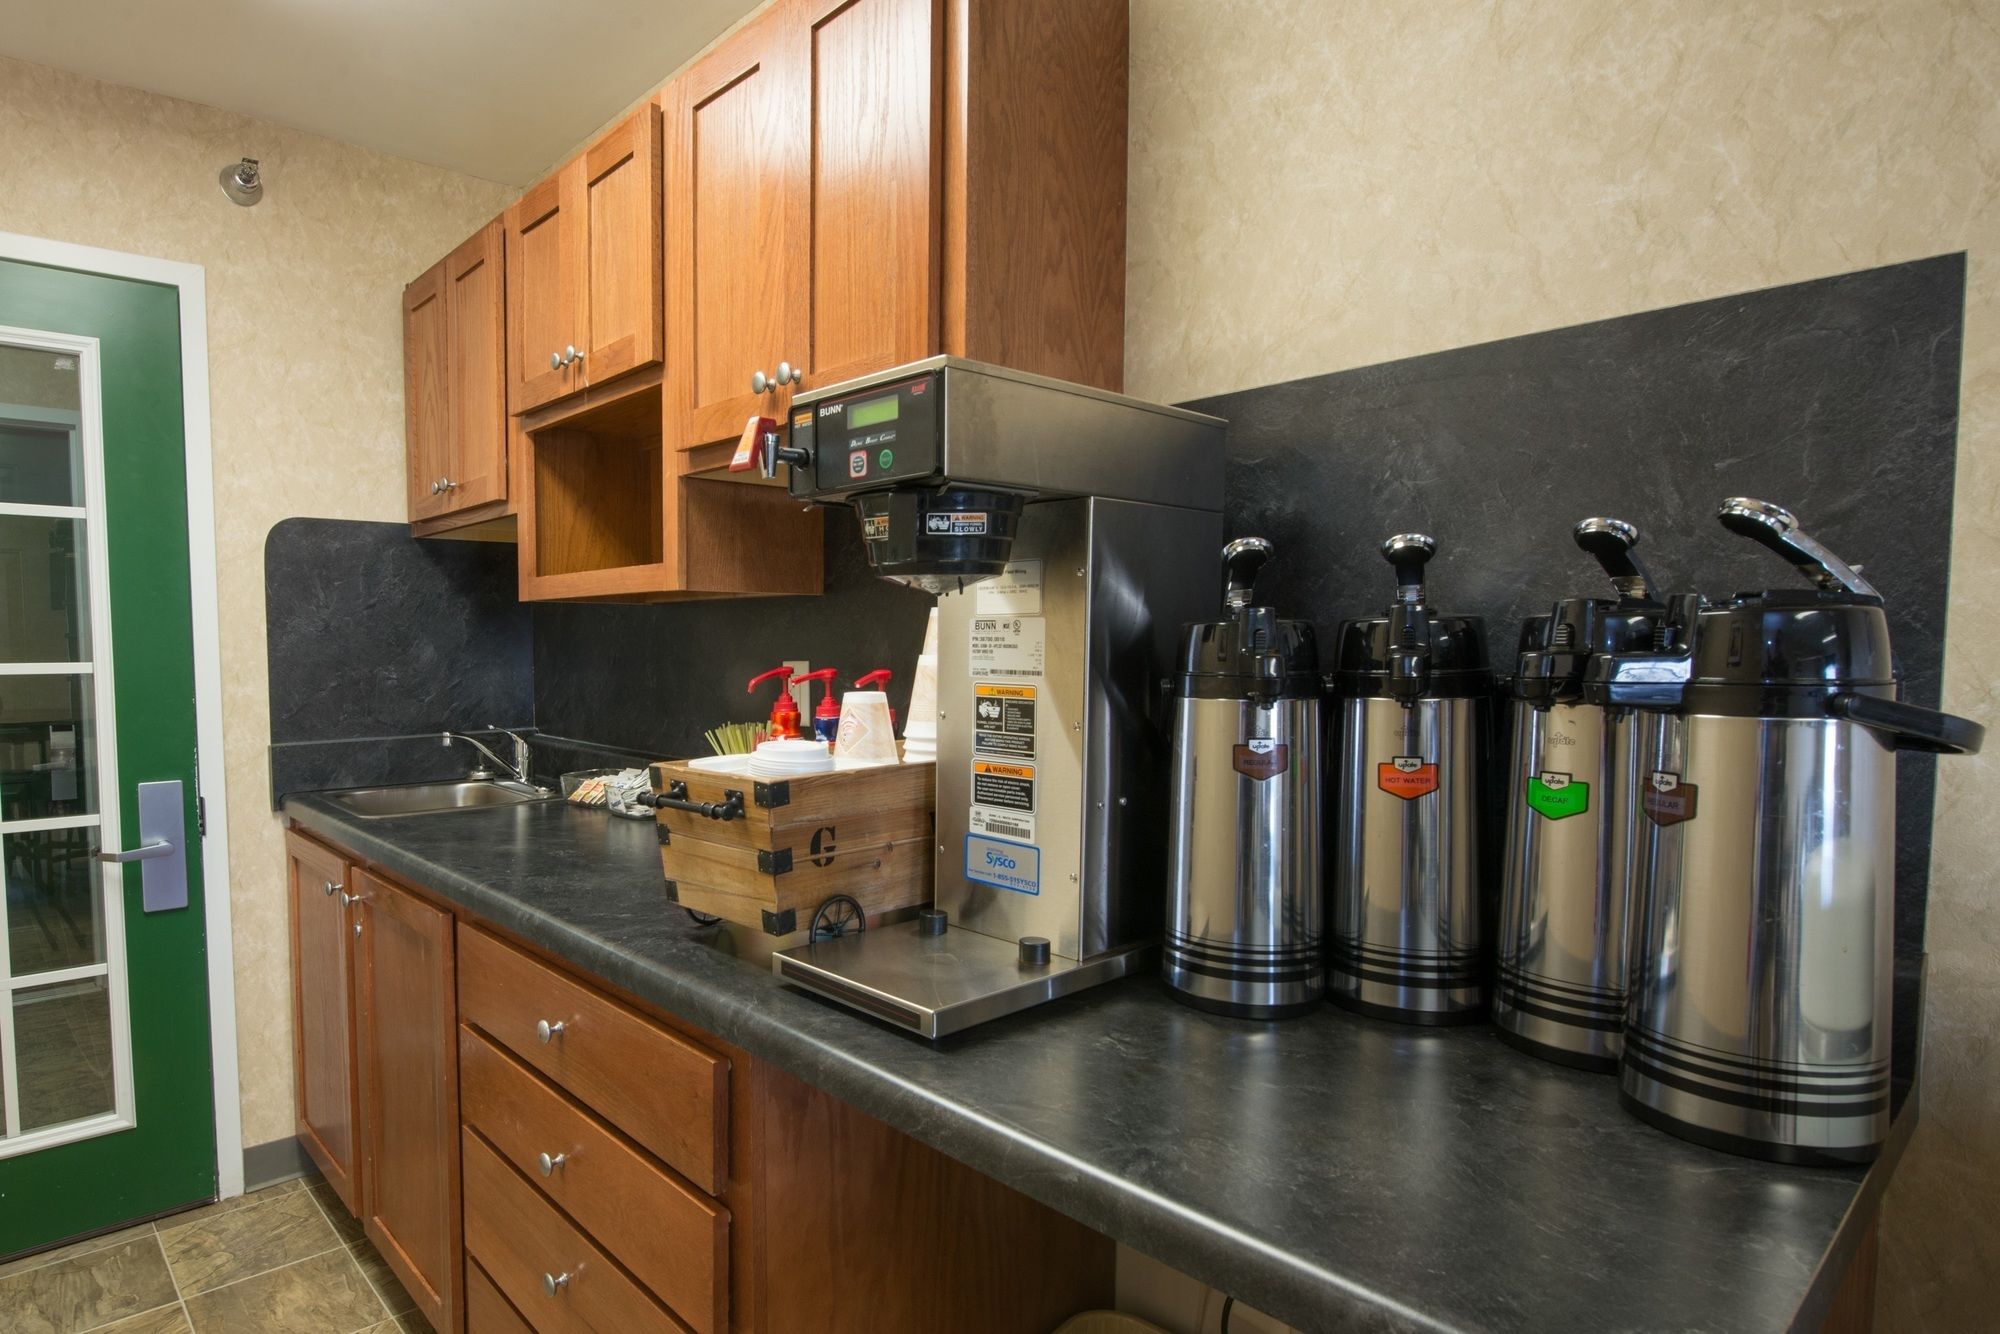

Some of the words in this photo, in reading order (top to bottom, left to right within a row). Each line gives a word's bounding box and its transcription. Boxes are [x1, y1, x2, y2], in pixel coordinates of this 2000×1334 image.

[820, 404, 842, 417] BUNN
[992, 766, 1023, 776] WARNING
[1541, 795, 1568, 804] DECAF
[810, 826, 836, 868] G
[986, 852, 1016, 868] Sysco
